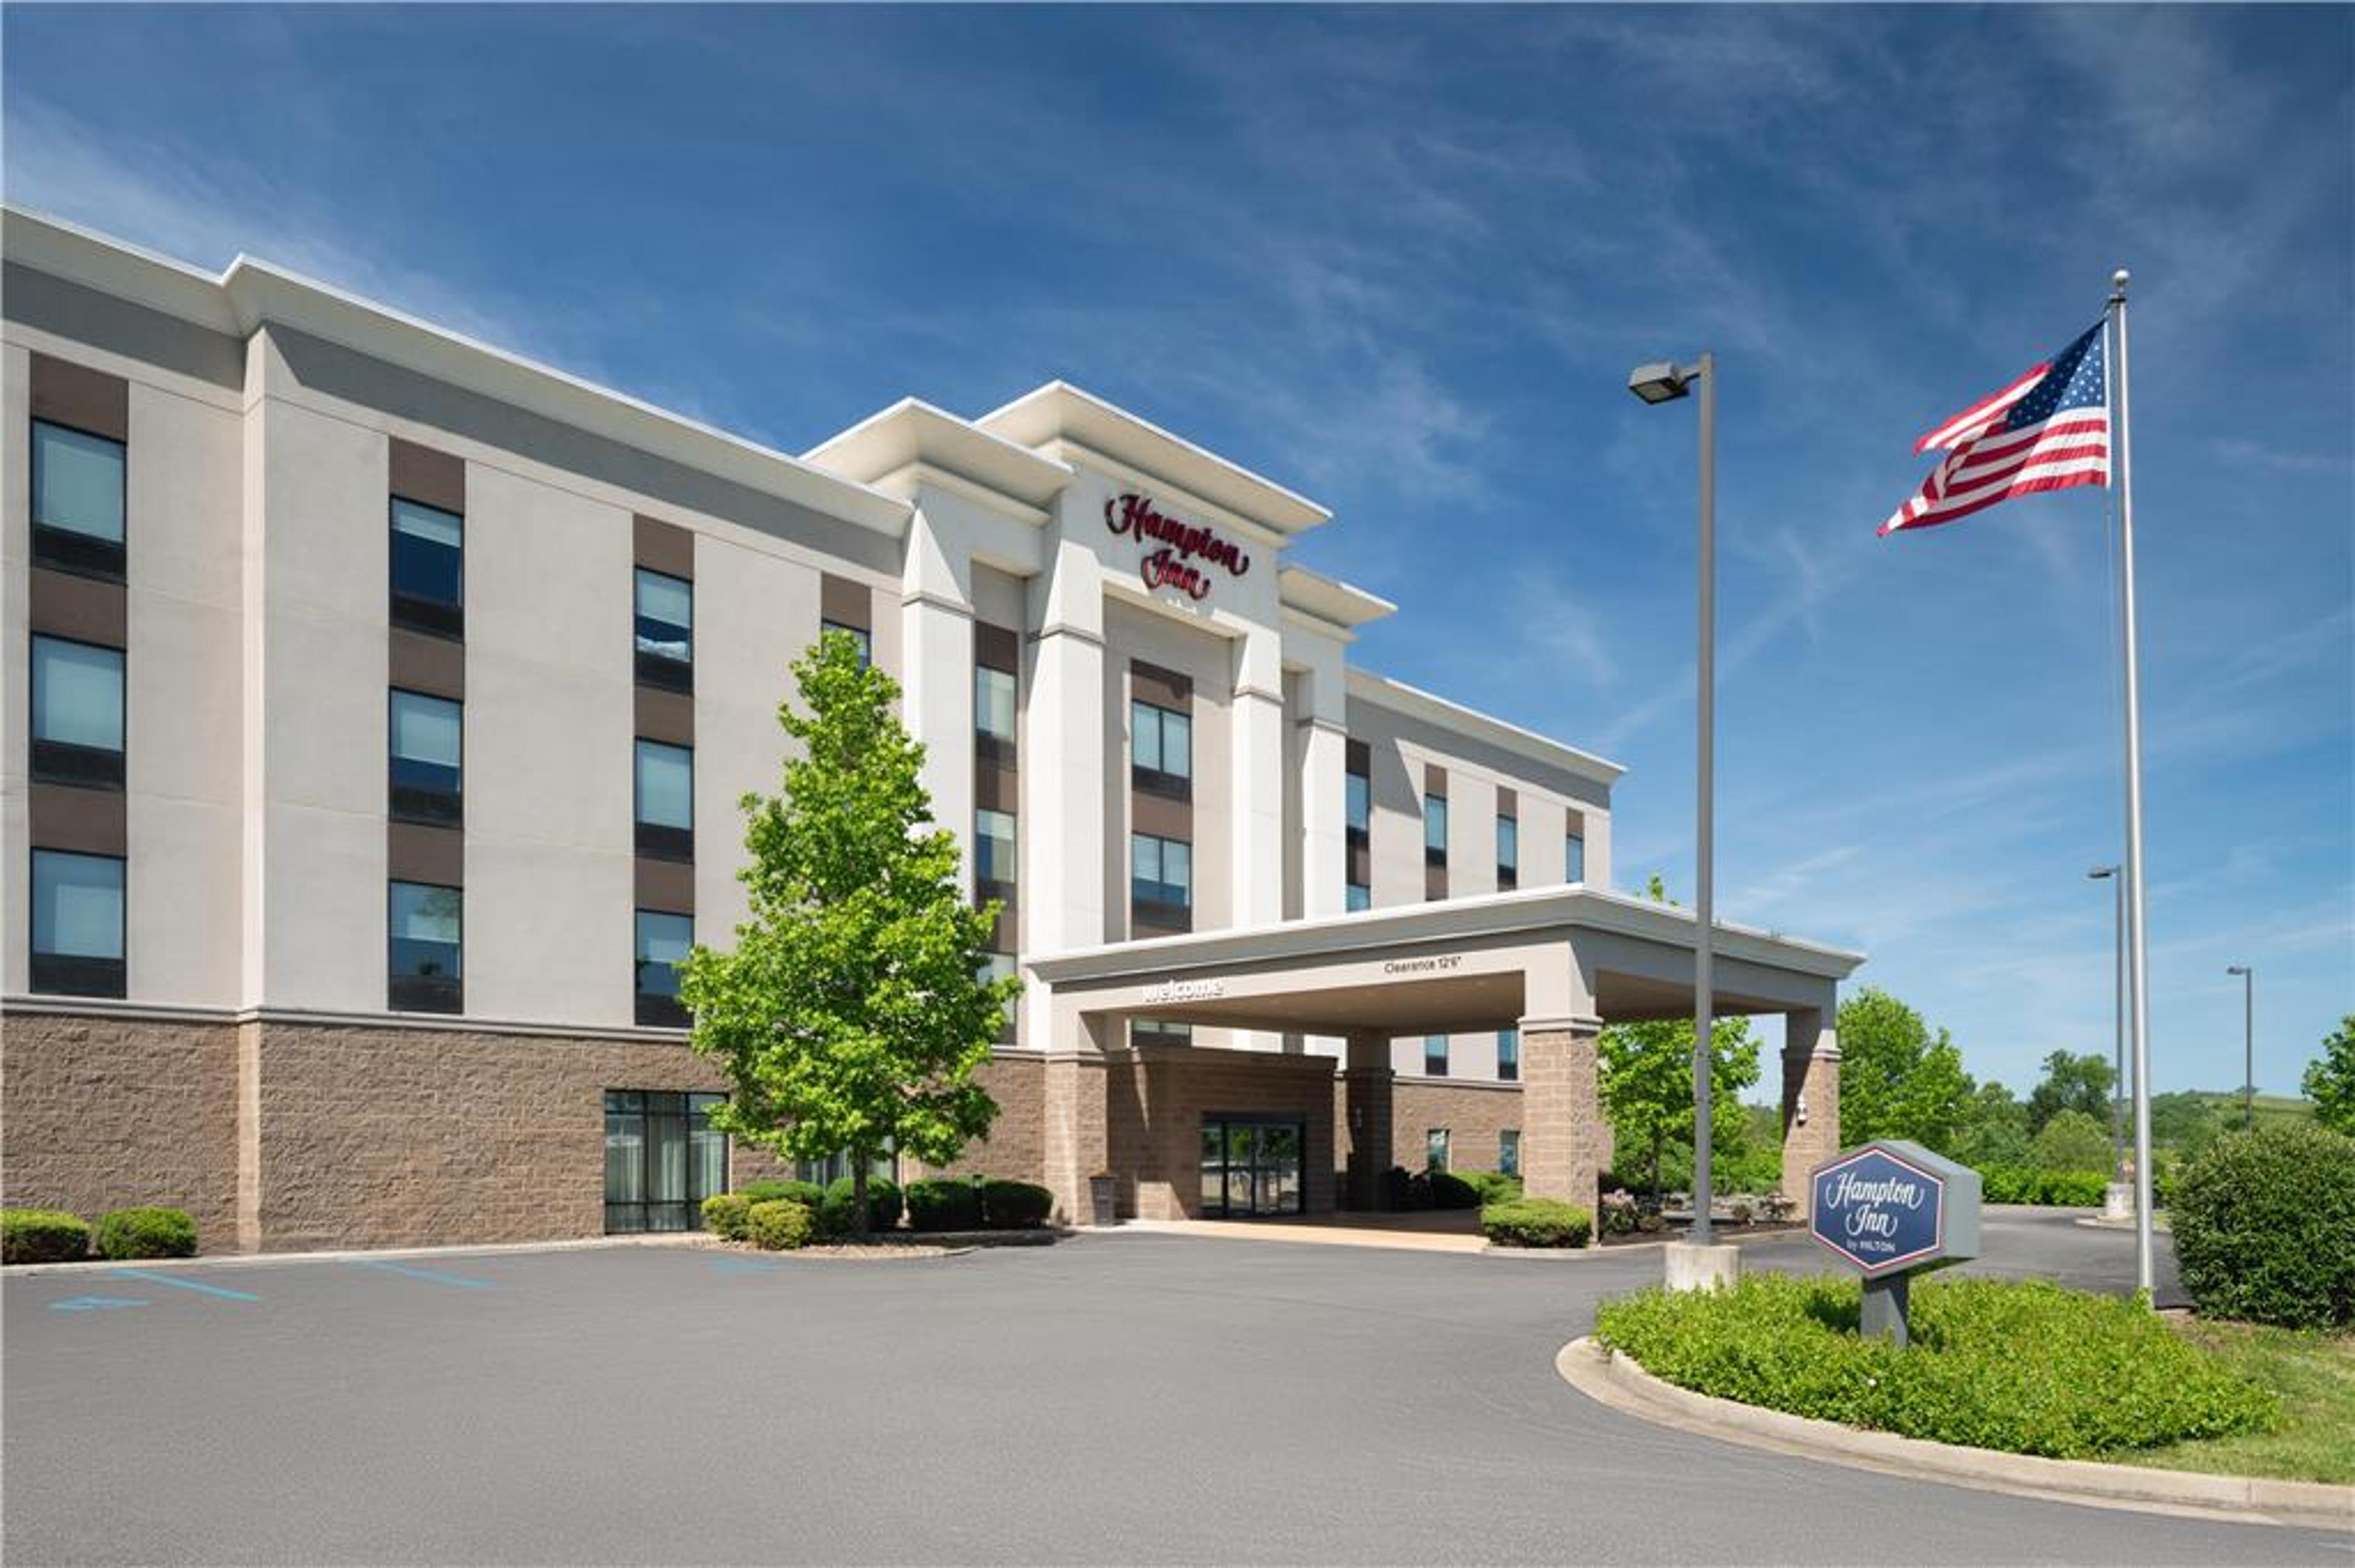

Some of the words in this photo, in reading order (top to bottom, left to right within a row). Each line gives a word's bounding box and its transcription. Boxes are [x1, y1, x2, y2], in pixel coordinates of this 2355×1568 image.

[1105, 494, 1250, 576] Hampton
[1141, 549, 1211, 601] Inn
[1384, 960, 1436, 973] Clearance
[1141, 979, 1224, 1001] welcome
[1825, 1172, 1926, 1210] Hampton
[1845, 1204, 1898, 1237] Inn
[1846, 1239, 1858, 1252] by
[1860, 1241, 1896, 1253] HILTON
